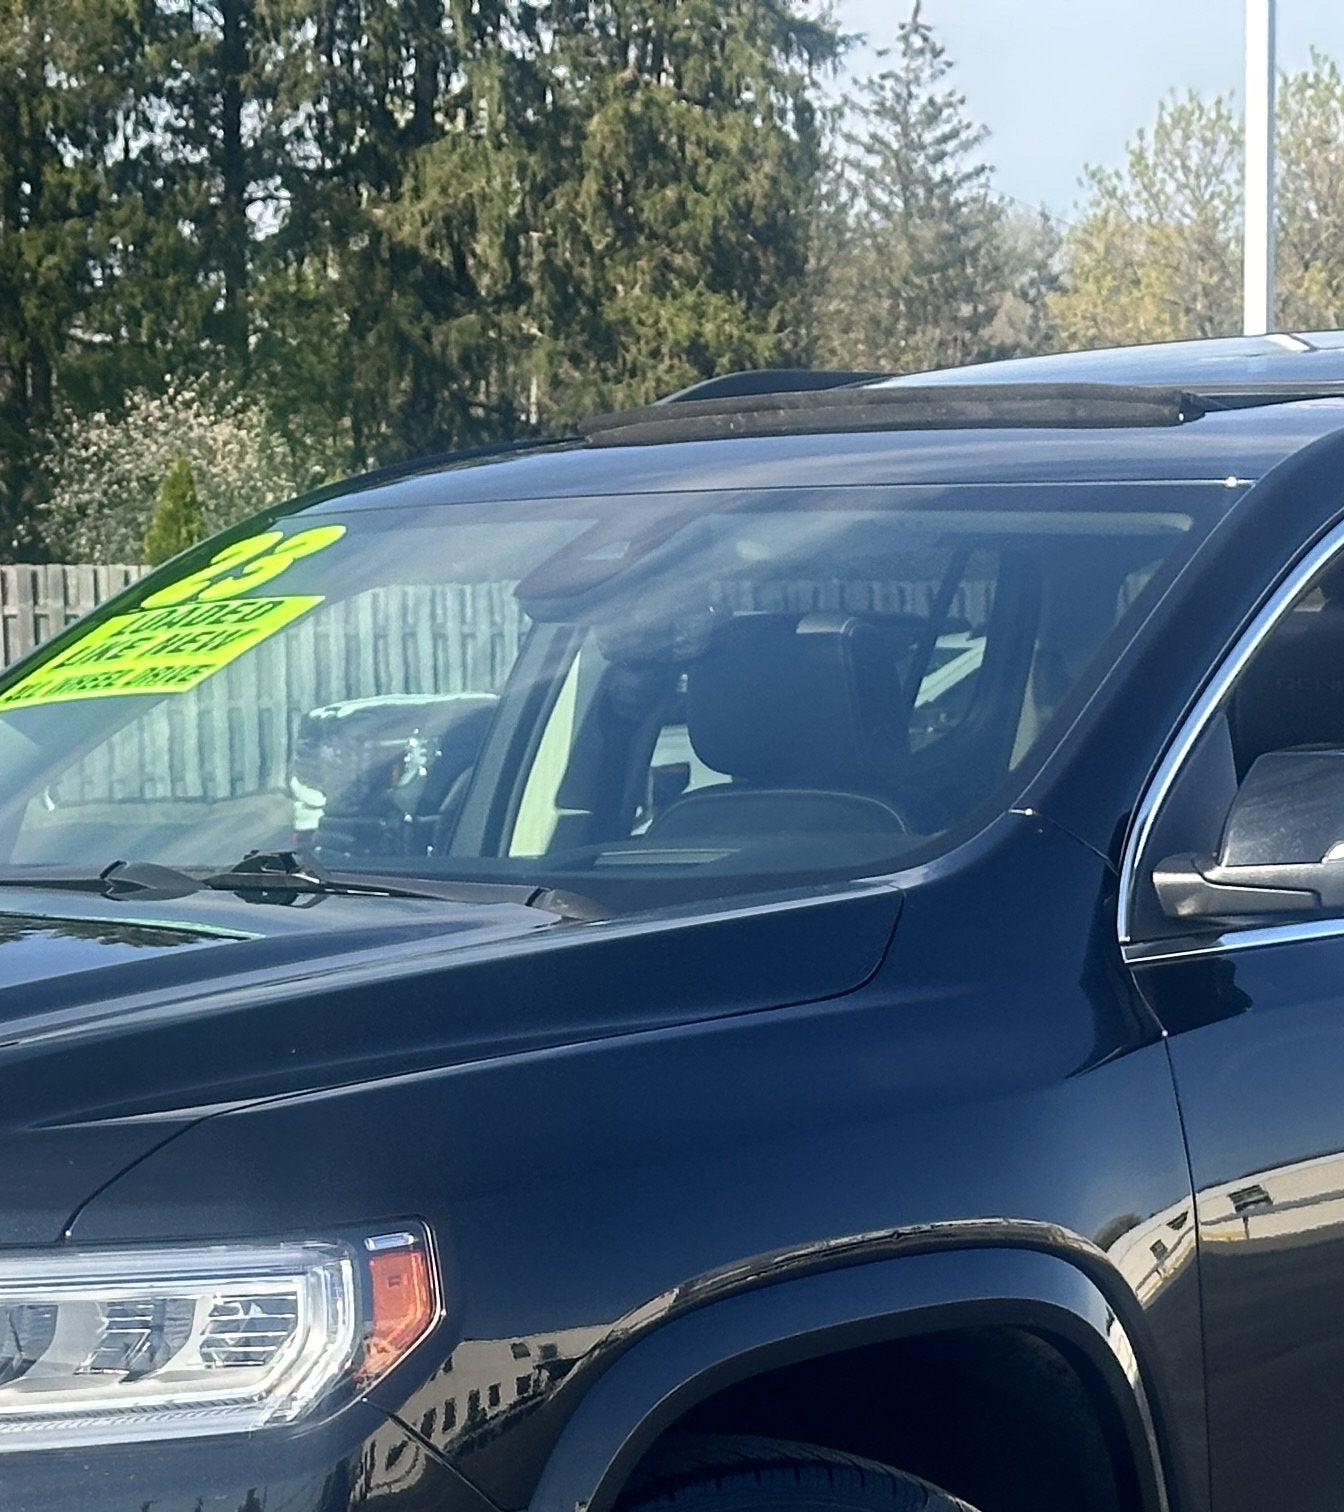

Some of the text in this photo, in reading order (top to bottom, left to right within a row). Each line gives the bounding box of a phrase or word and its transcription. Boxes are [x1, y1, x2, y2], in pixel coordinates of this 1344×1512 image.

[140, 524, 347, 609] 23
[109, 599, 285, 638] LOADED
[47, 627, 259, 671] LIKE NEW
[38, 668, 135, 698] WHEEL
[121, 663, 217, 688] DRIVE
